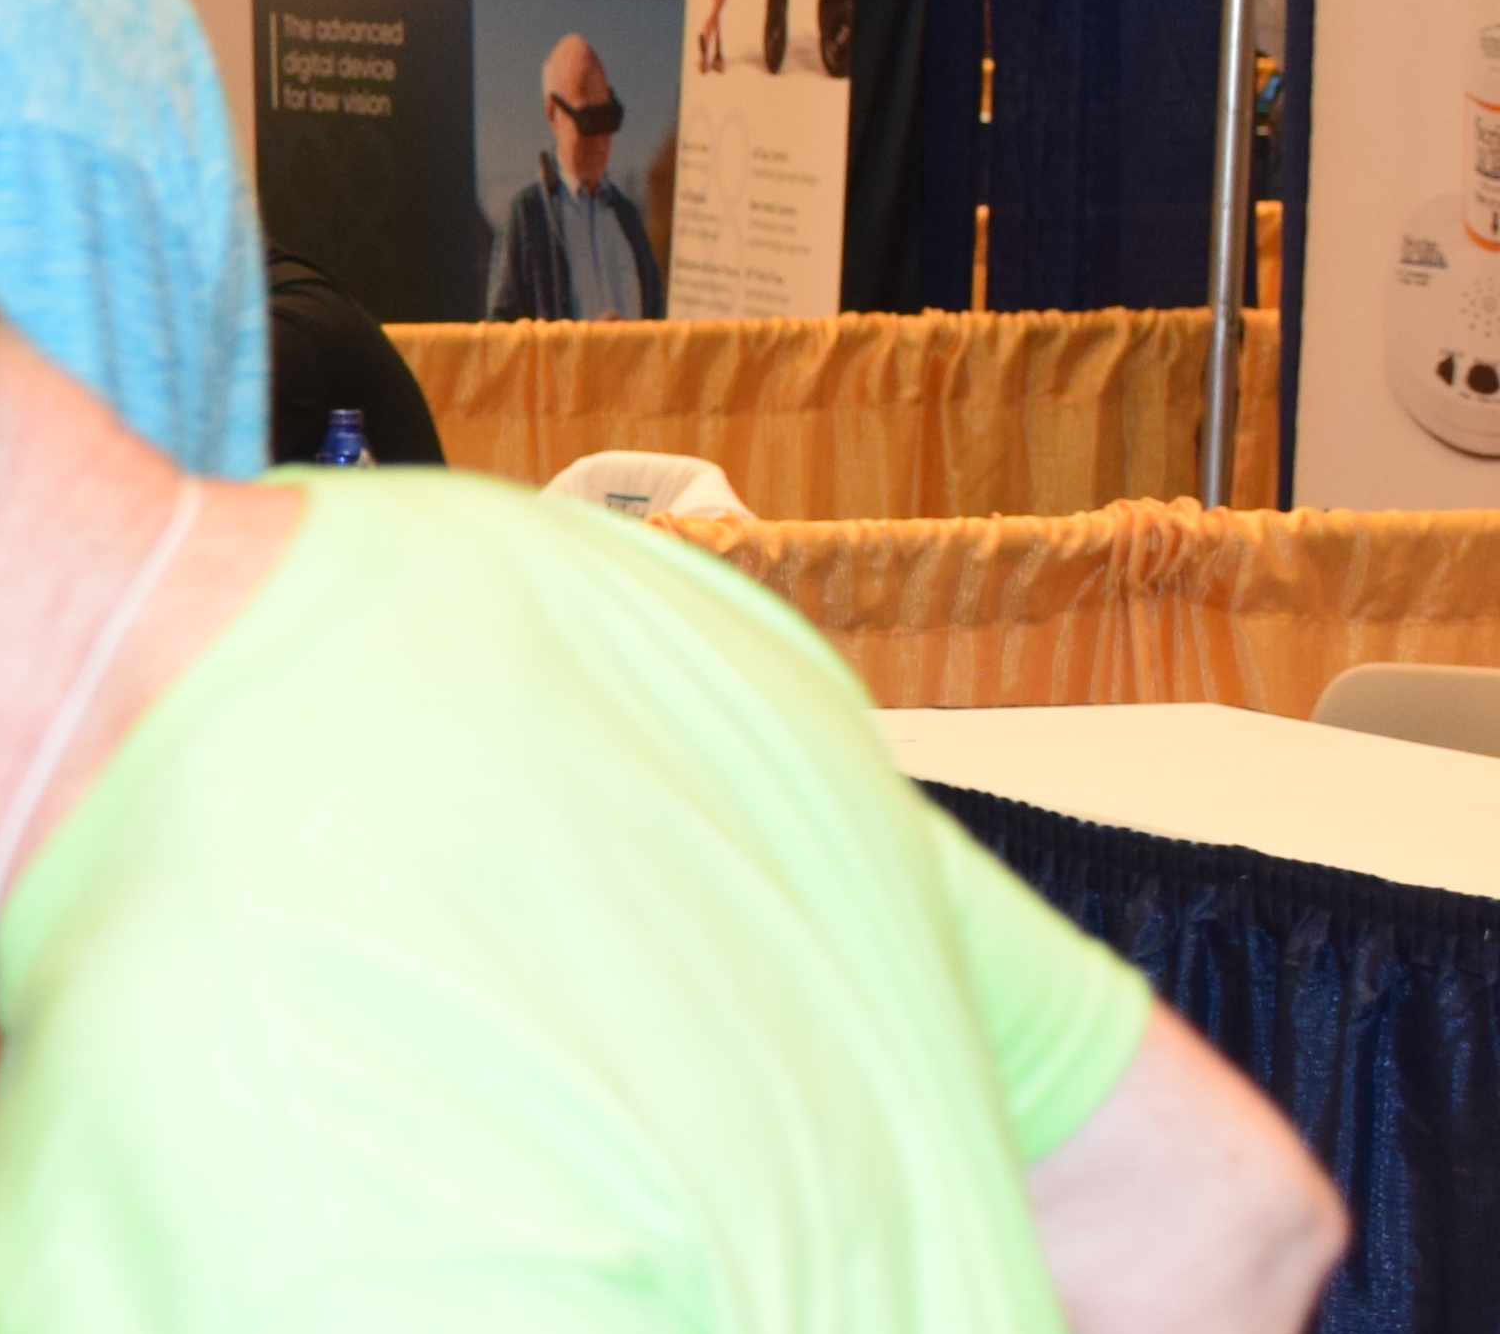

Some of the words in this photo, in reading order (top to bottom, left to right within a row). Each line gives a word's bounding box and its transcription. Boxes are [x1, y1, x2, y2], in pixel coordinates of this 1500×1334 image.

[283, 13, 314, 41] The
[315, 18, 405, 47] advanced
[283, 49, 336, 84] digital
[338, 53, 398, 82] device
[283, 83, 308, 111] for
[309, 87, 340, 113] low
[341, 88, 393, 117] vision
